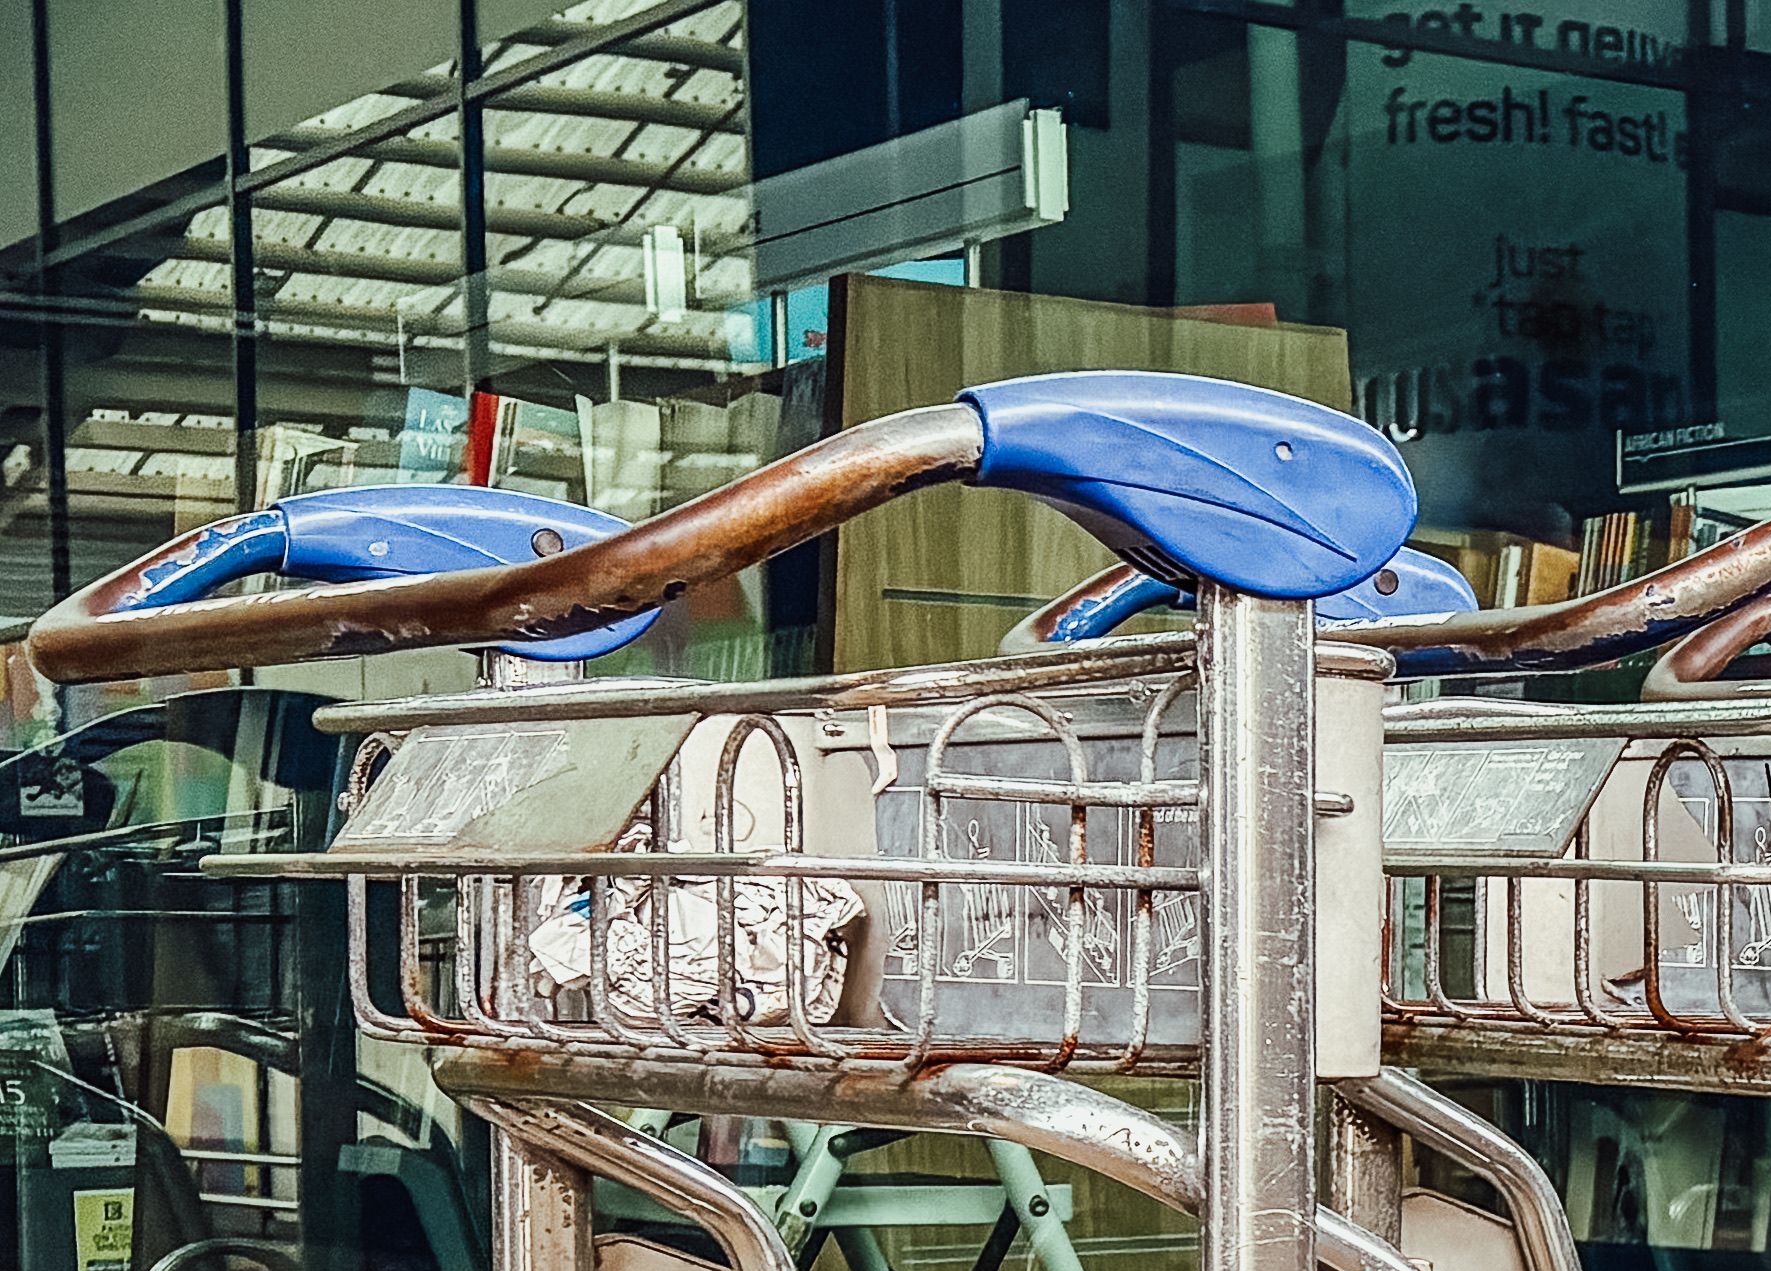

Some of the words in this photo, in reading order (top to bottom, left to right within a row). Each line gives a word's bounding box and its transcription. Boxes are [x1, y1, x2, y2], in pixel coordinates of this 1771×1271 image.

[1386, 85, 1550, 145] fresh!
[1562, 95, 1669, 163] fast!
[1624, 430, 1674, 452] AFRICAN
[1676, 421, 1725, 446] FICTION
